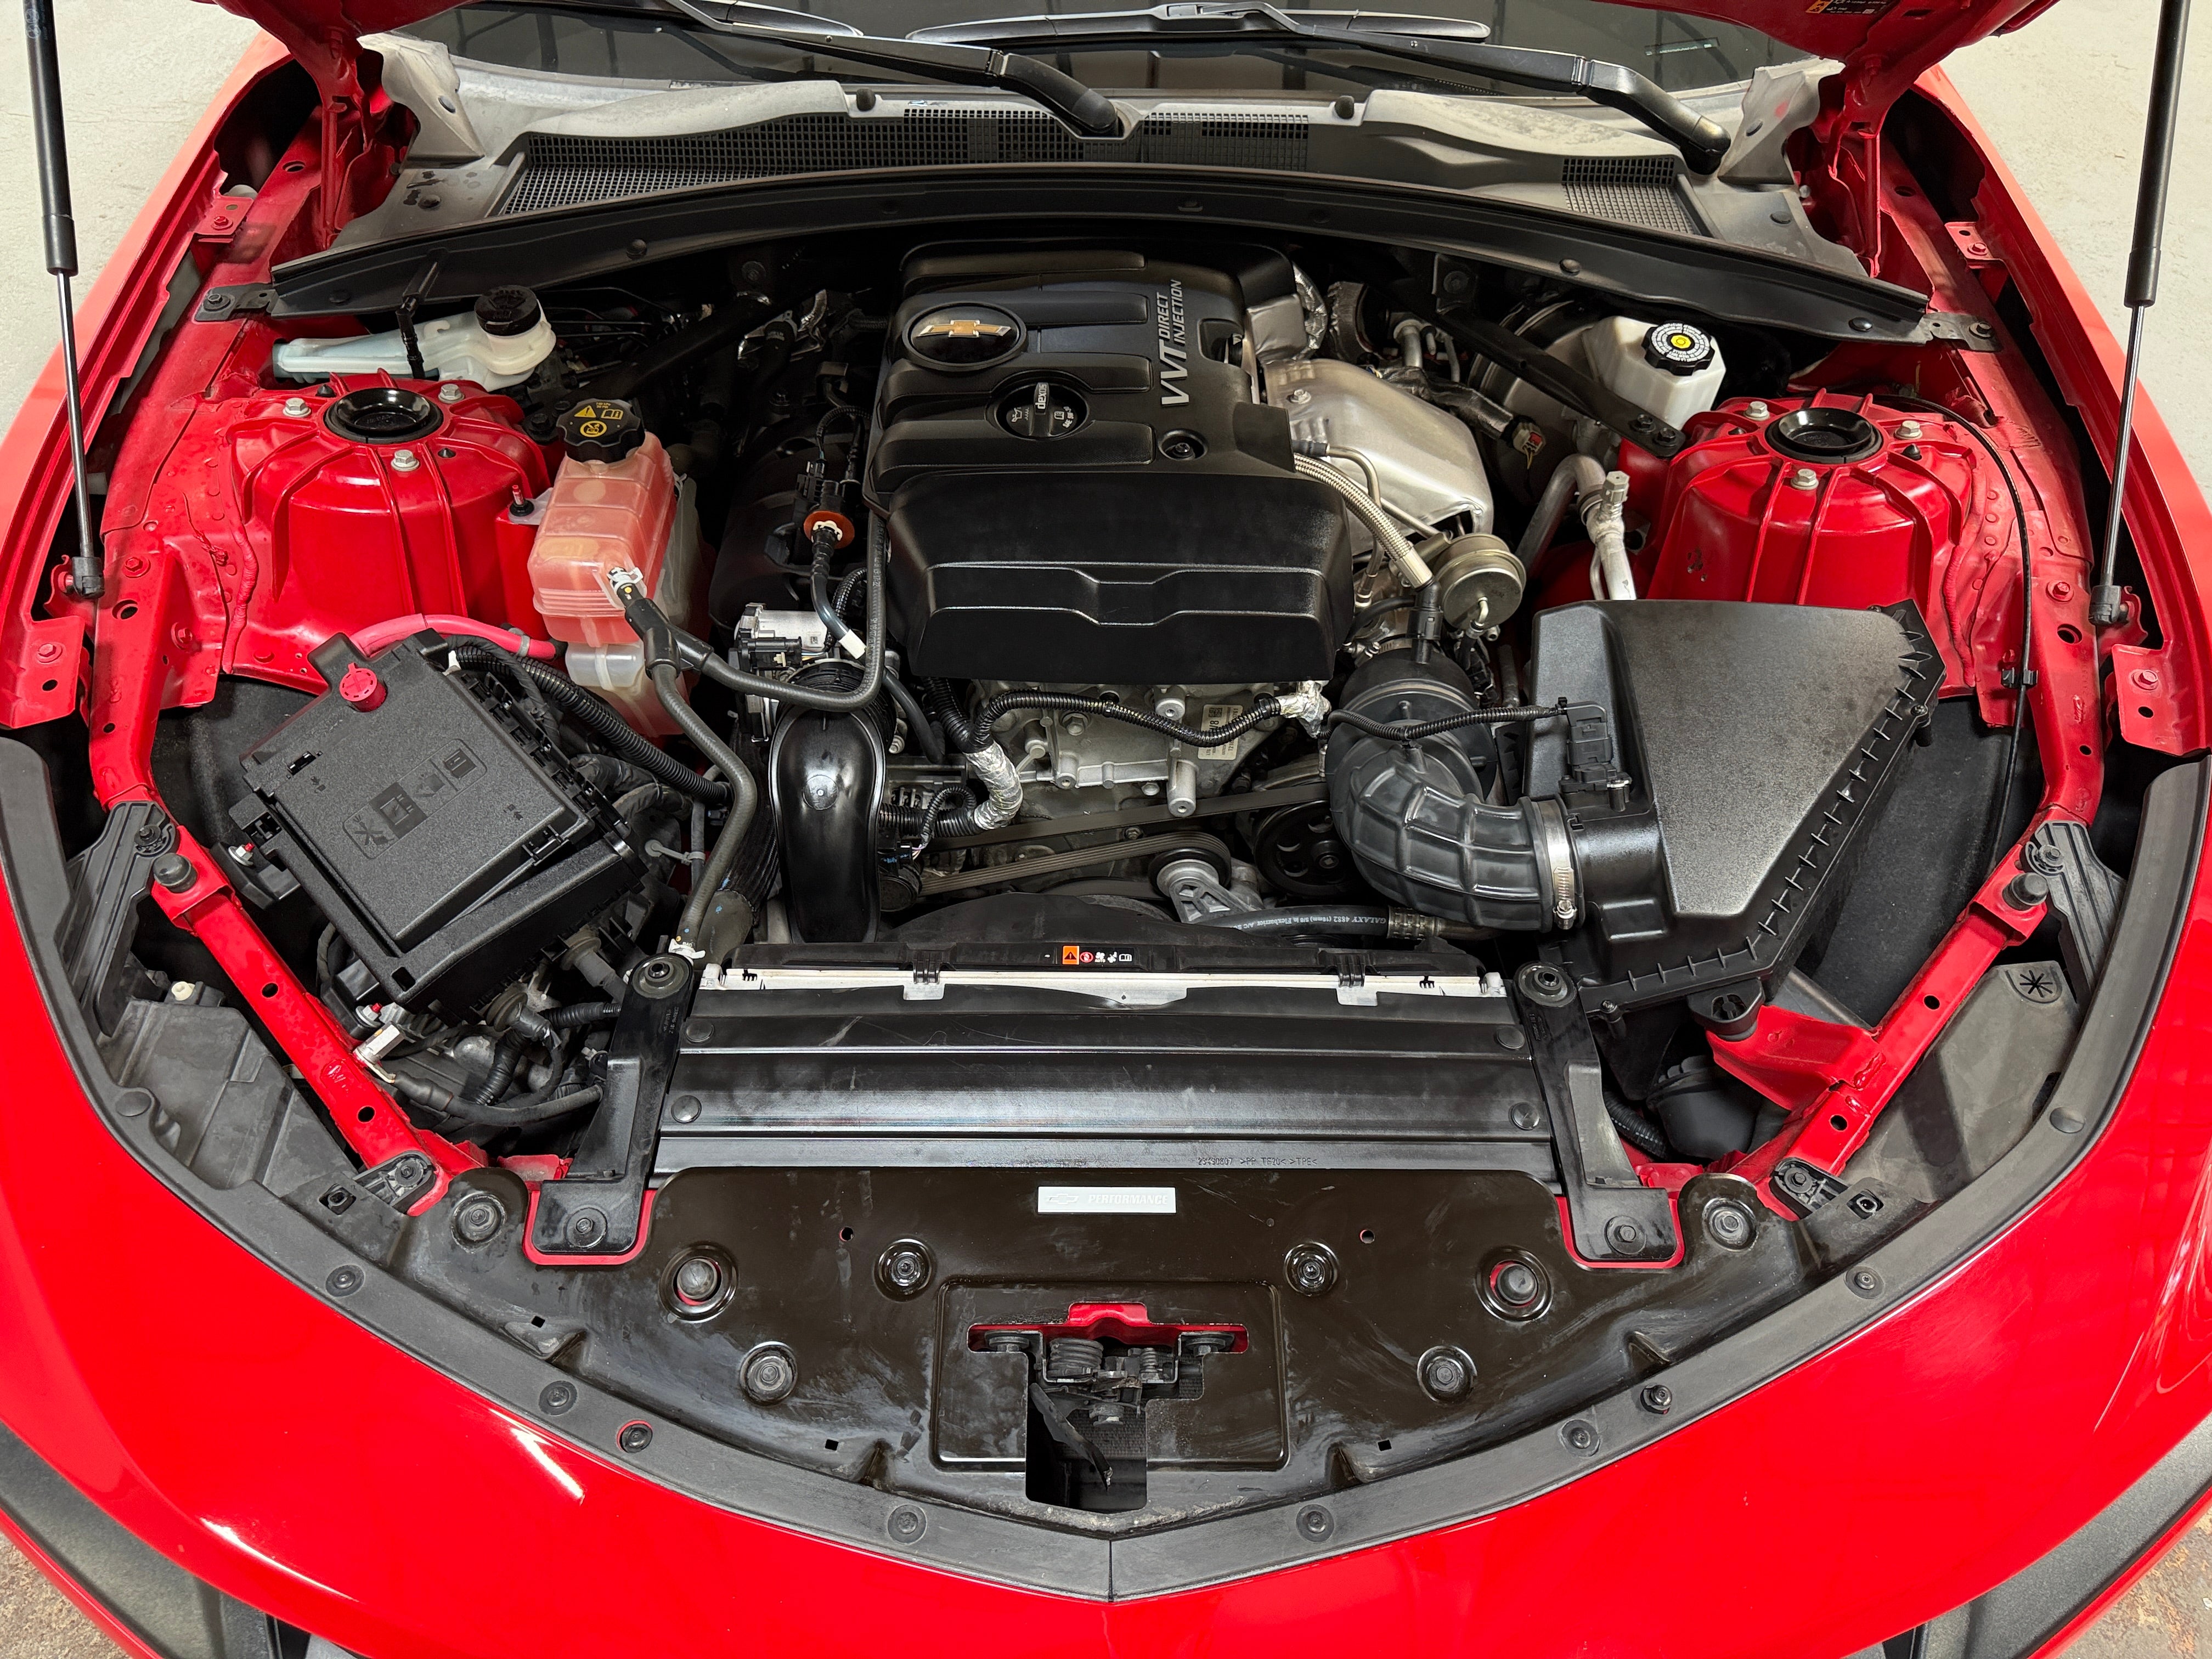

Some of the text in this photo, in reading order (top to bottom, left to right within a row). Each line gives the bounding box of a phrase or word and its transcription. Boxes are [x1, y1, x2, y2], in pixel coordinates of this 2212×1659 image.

[1156, 291, 1170, 340] DIRECT
[1170, 279, 1186, 345] INJECTION
[1159, 338, 1189, 405] VVT
[1035, 383, 1047, 410] dexos
[1243, 921, 1254, 929] A/C
[1256, 917, 1293, 927] Flexbarrier
[1351, 916, 1387, 924] GALAXY
[1289, 1157, 1317, 1166] >TPE<
[1087, 1194, 1168, 1205] PERFORMANCE
